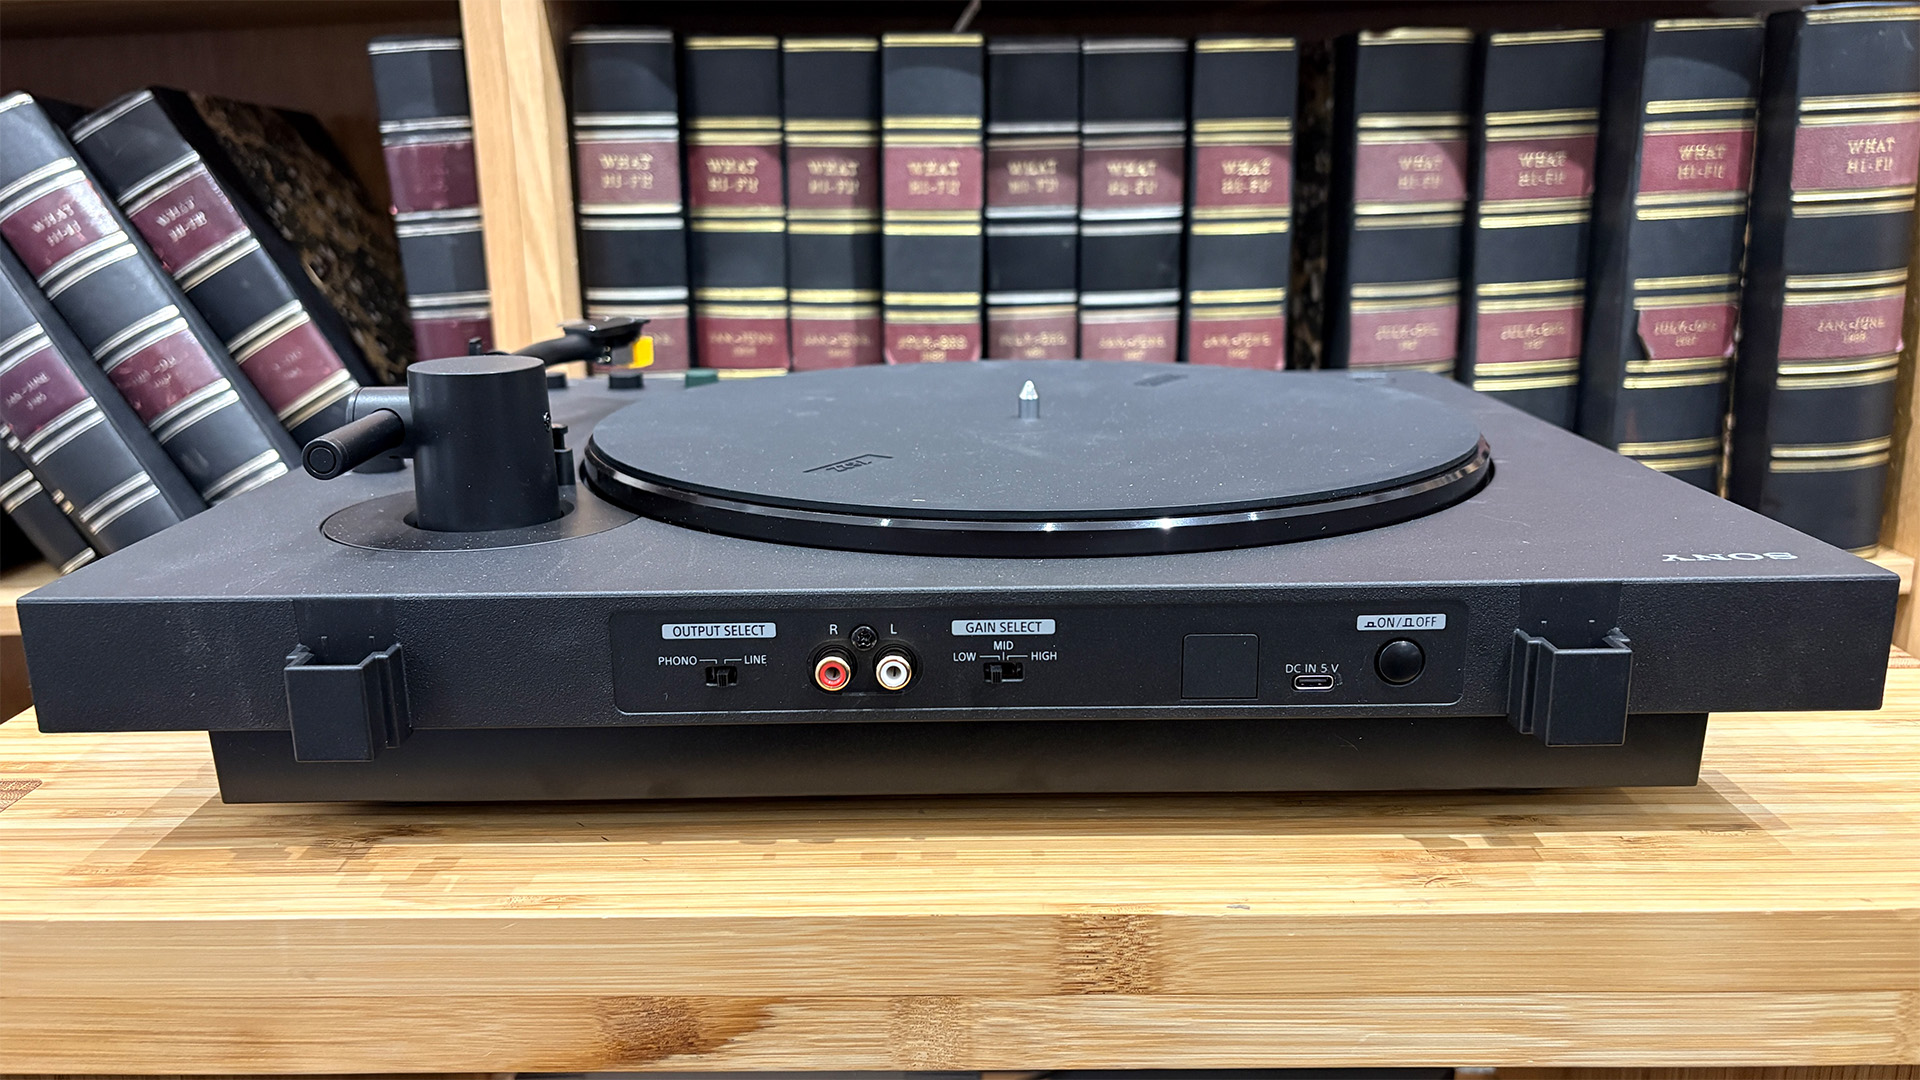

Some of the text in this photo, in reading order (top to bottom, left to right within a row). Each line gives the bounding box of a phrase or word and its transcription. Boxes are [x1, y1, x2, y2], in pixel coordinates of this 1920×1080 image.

[1679, 144, 1727, 160] WHAT
[1848, 137, 1896, 155] WHAT
[600, 152, 654, 171] WHAT
[706, 157, 758, 174] WHAT
[1006, 158, 1058, 175] WHAT
[1221, 158, 1271, 176] WHAT
[1398, 154, 1443, 171] WHAT
[1518, 150, 1567, 168] WHAT
[1846, 157, 1894, 175] HI-FI
[807, 159, 859, 176] WHAT
[907, 160, 960, 177] WHAT
[1107, 159, 1157, 177] WHAT
[1677, 164, 1725, 180] HI-FI
[1662, 552, 1798, 562] SONY
[672, 624, 766, 638] OUTPUT SELECT
[829, 624, 838, 634] R
[890, 624, 898, 634] L
[965, 621, 1042, 633] GAIN SELECT
[993, 640, 1014, 650] MID
[658, 655, 698, 665] PHONO
[744, 655, 767, 665] LINE
[952, 652, 977, 662] LOW
[1031, 651, 1057, 662] HIGH
[1285, 663, 1301, 674] DC
[1305, 663, 1316, 674] IN
